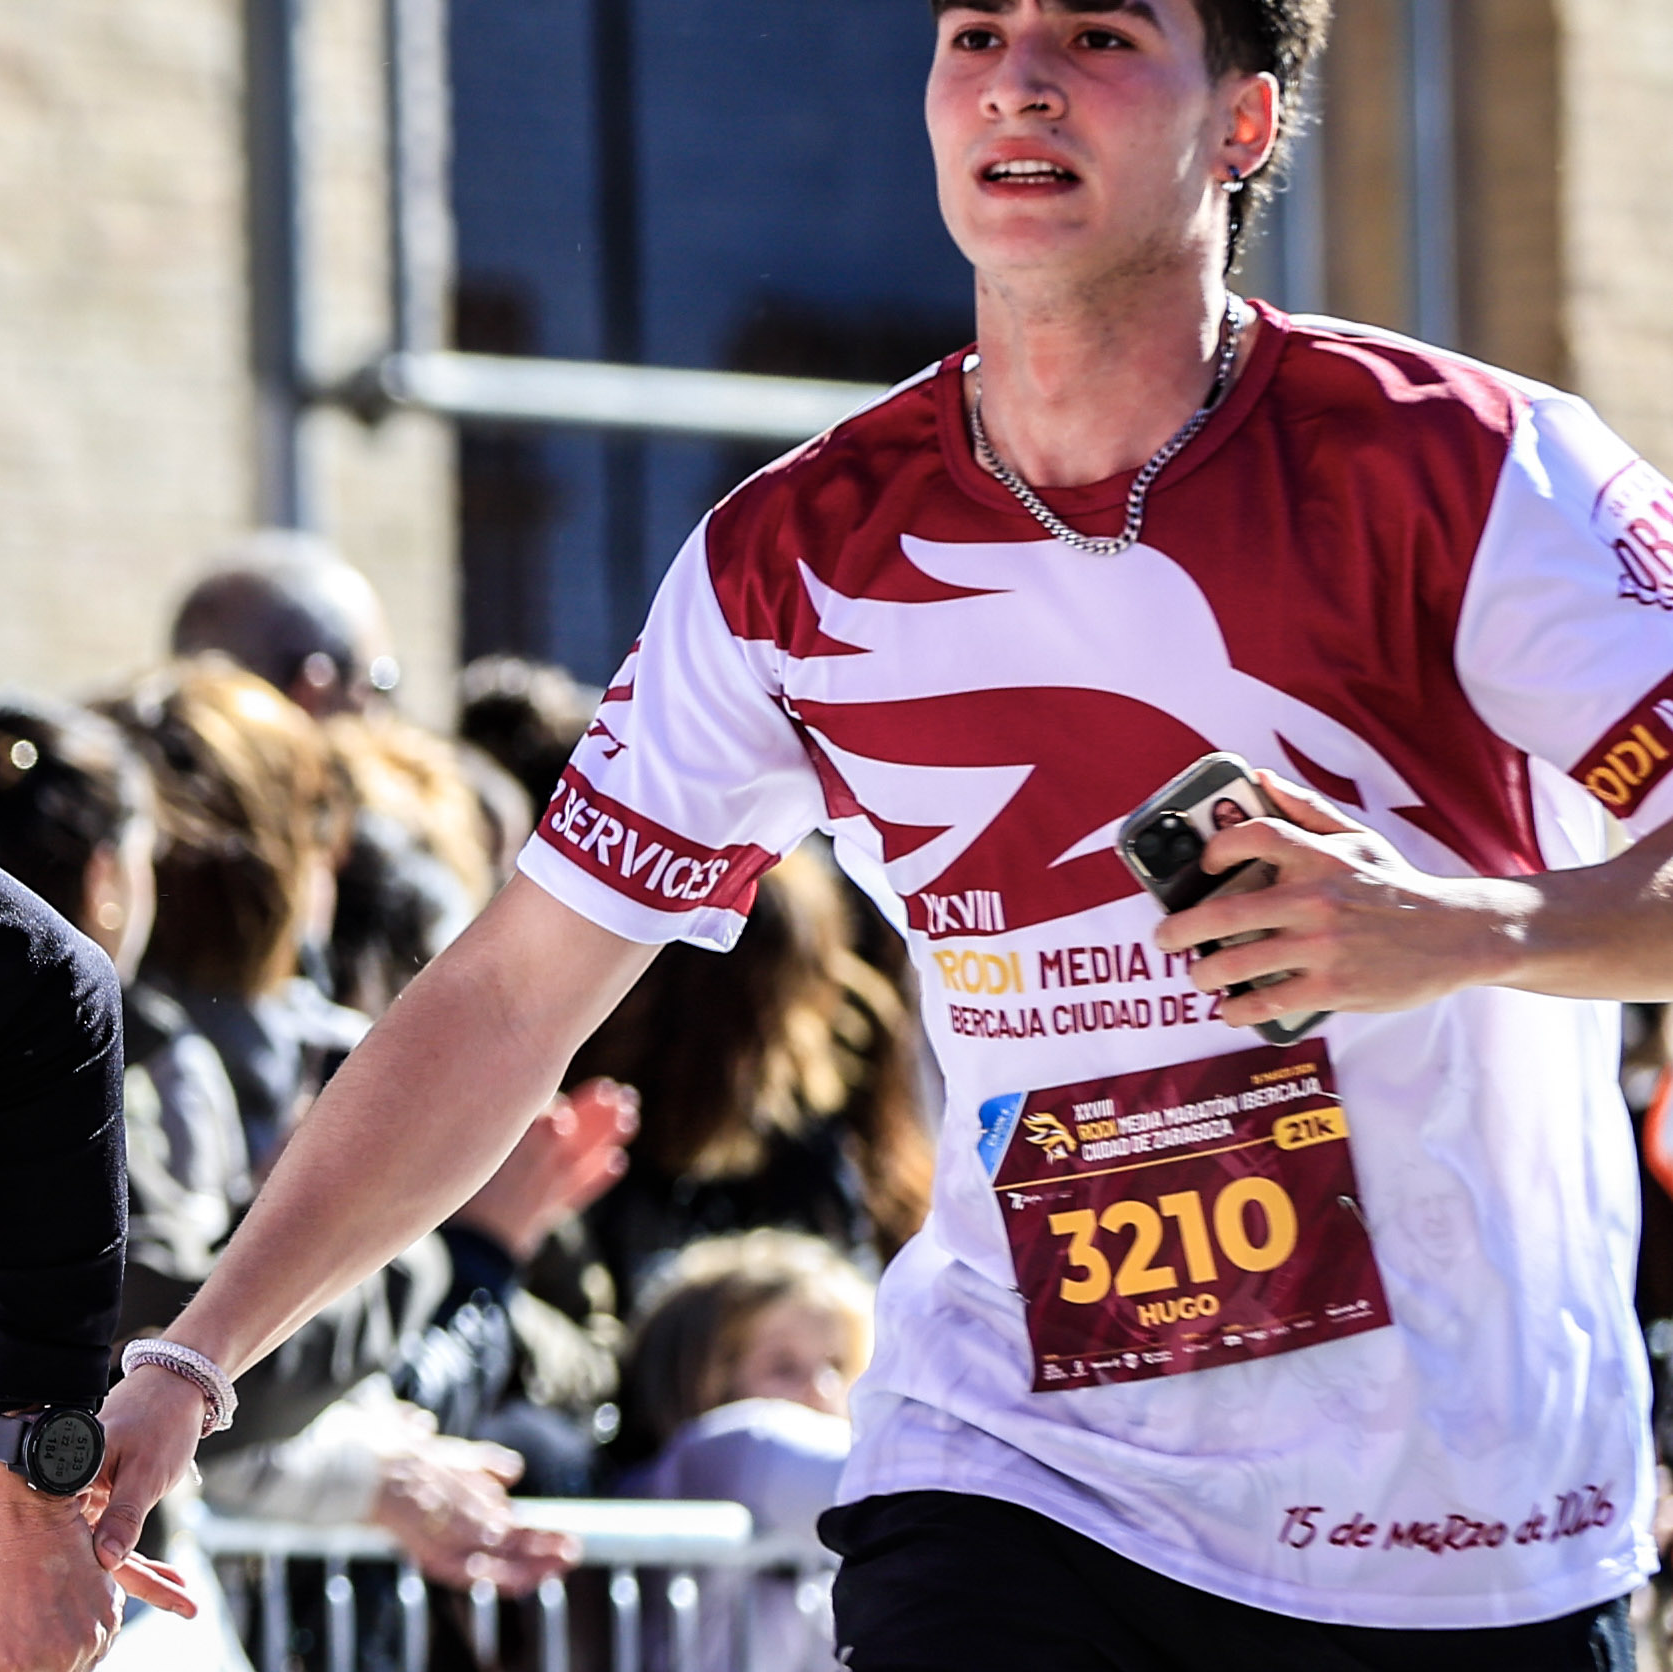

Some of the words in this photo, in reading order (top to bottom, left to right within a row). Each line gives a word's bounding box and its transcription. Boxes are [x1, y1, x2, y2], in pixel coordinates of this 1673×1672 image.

[551, 788, 729, 899] SERVICES
[932, 950, 1024, 994] RODI
[1038, 942, 1152, 989] MEDIA
[1053, 999, 1152, 1035] CIUDAD
[1160, 992, 1198, 1026] DE
[1285, 1116, 1336, 1141] 21k
[1048, 1176, 1297, 1304] 3210
[1137, 1293, 1220, 1327] HUGO
[1278, 1507, 1325, 1549] 15
[1327, 1512, 1378, 1548] de
